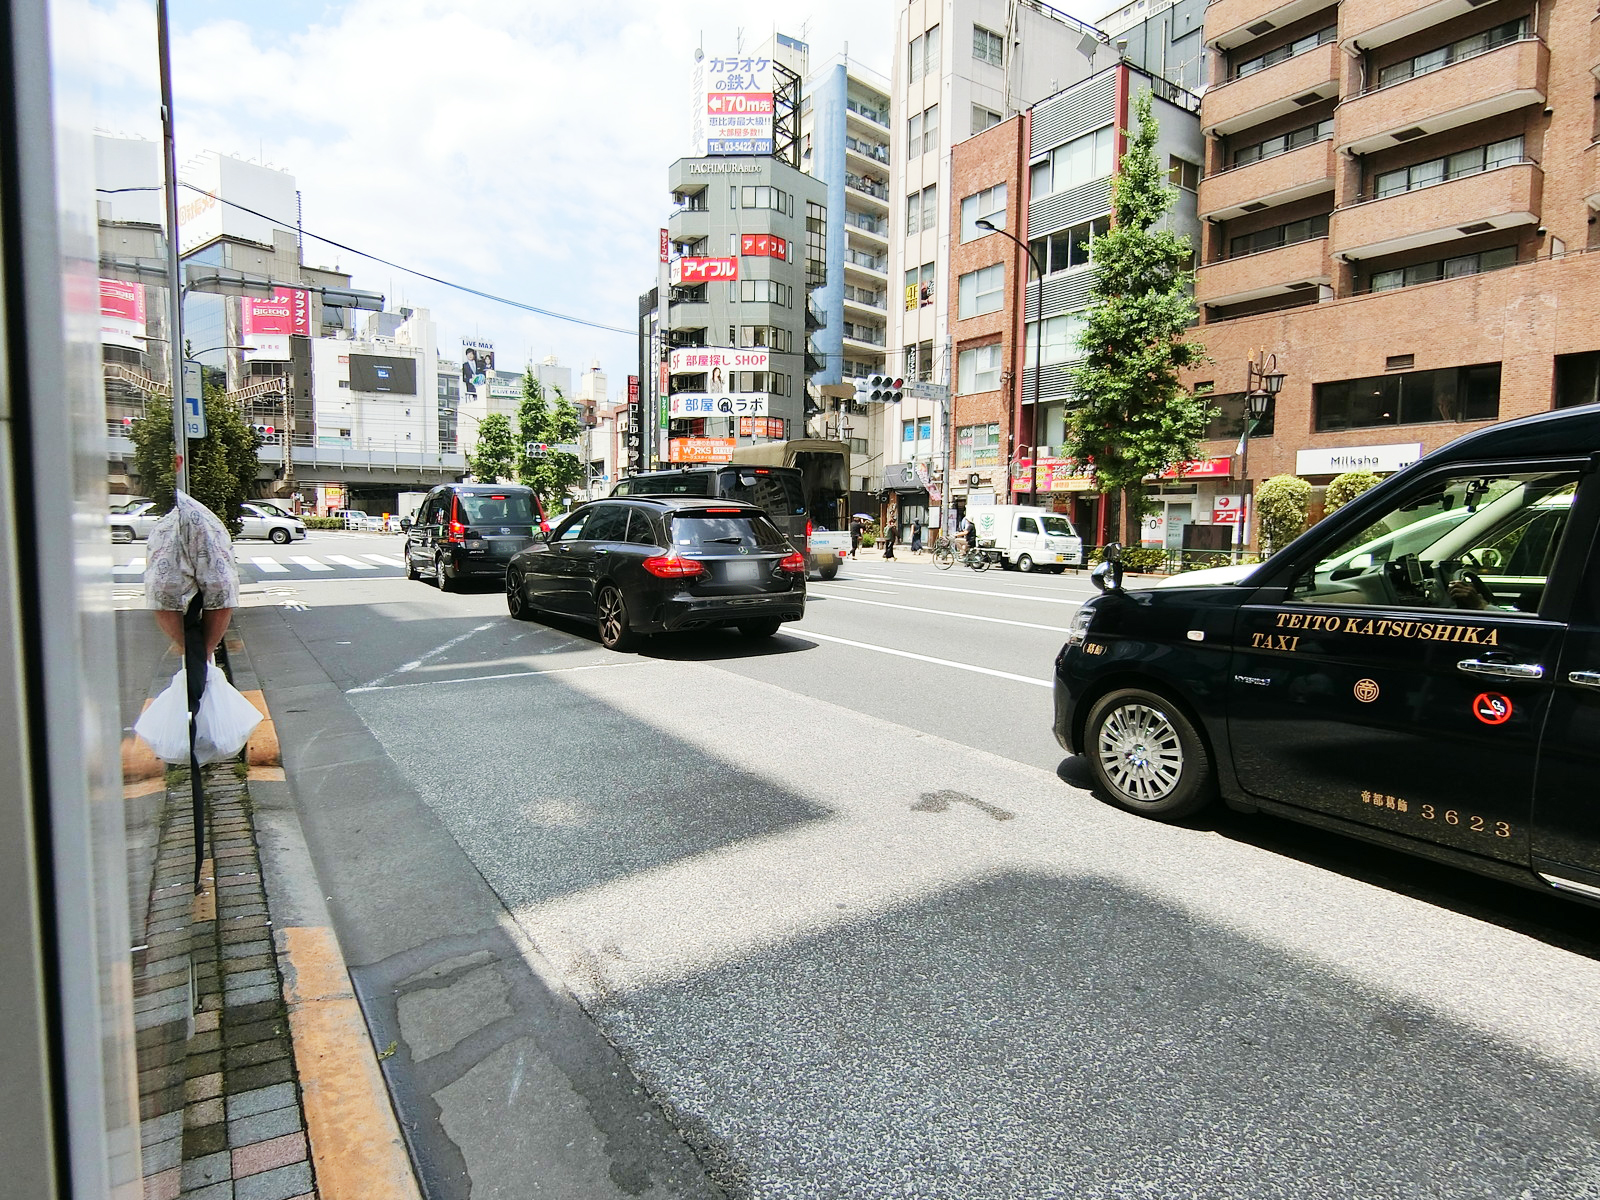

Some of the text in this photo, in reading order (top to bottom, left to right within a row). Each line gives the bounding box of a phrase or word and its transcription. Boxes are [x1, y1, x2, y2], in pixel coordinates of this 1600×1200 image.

[709, 57, 771, 73] カラオケ
[715, 74, 760, 91] の鉄人
[728, 96, 771, 112] 70m先
[709, 117, 771, 127] 恵比寿最大級!!
[709, 142, 723, 151] TEL
[689, 164, 744, 174] TACHIMURA
[743, 240, 785, 254] アイフル
[683, 262, 735, 276] アイフル
[295, 291, 305, 326] カラオケ
[686, 354, 767, 366] 部屋探し SHOP
[685, 398, 763, 412] 部屋 ラボ
[188, 424, 199, 433] 19
[683, 446, 711, 455] WORKS
[1331, 455, 1379, 466] Milksha
[1276, 613, 1498, 646] TEITO KATSUSHIKA
[1251, 633, 1300, 652] TAXI
[1361, 790, 1408, 813] 帝都葛飾
